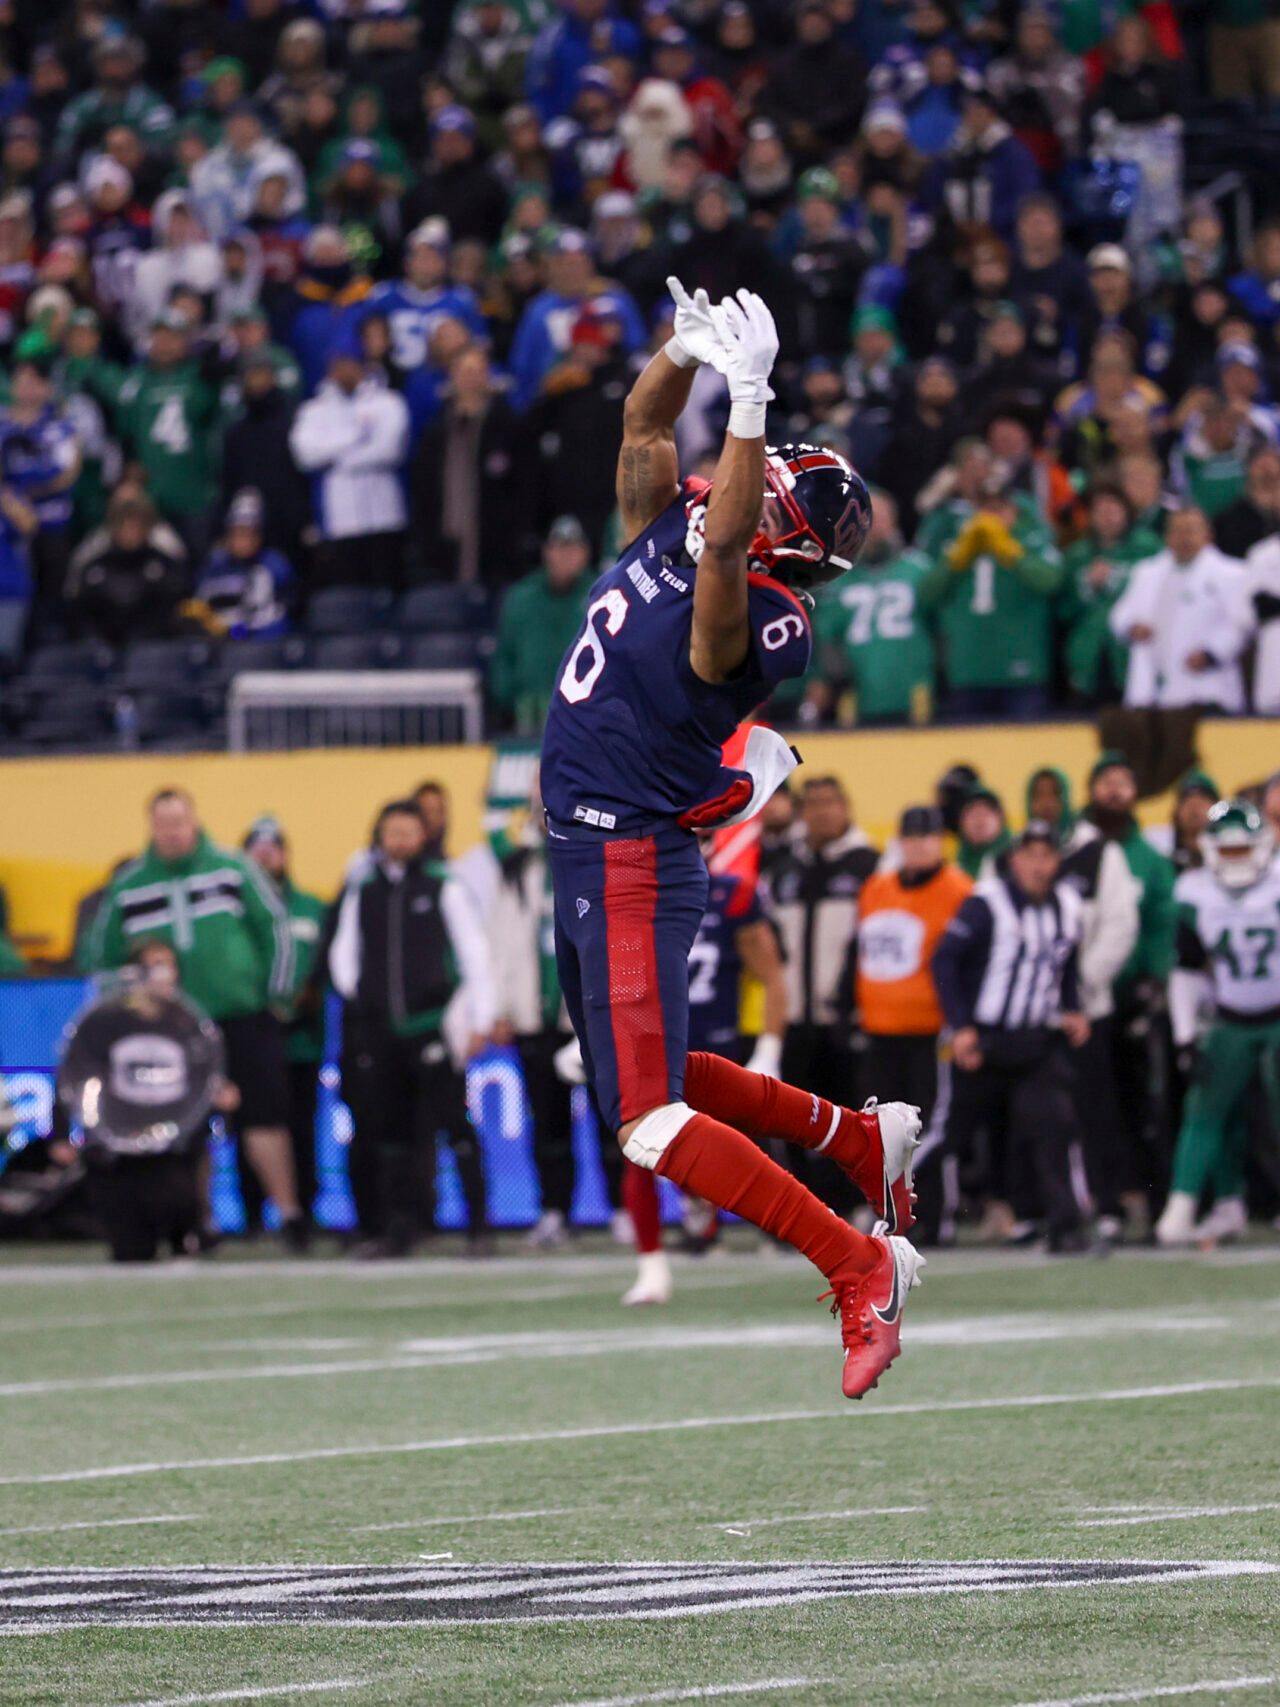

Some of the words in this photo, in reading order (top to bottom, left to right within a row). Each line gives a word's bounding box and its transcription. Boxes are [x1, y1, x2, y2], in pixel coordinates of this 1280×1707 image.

[659, 567, 689, 593] TELUS
[761, 613, 804, 651] 6
[840, 581, 914, 644] 72
[560, 588, 629, 704] 6
